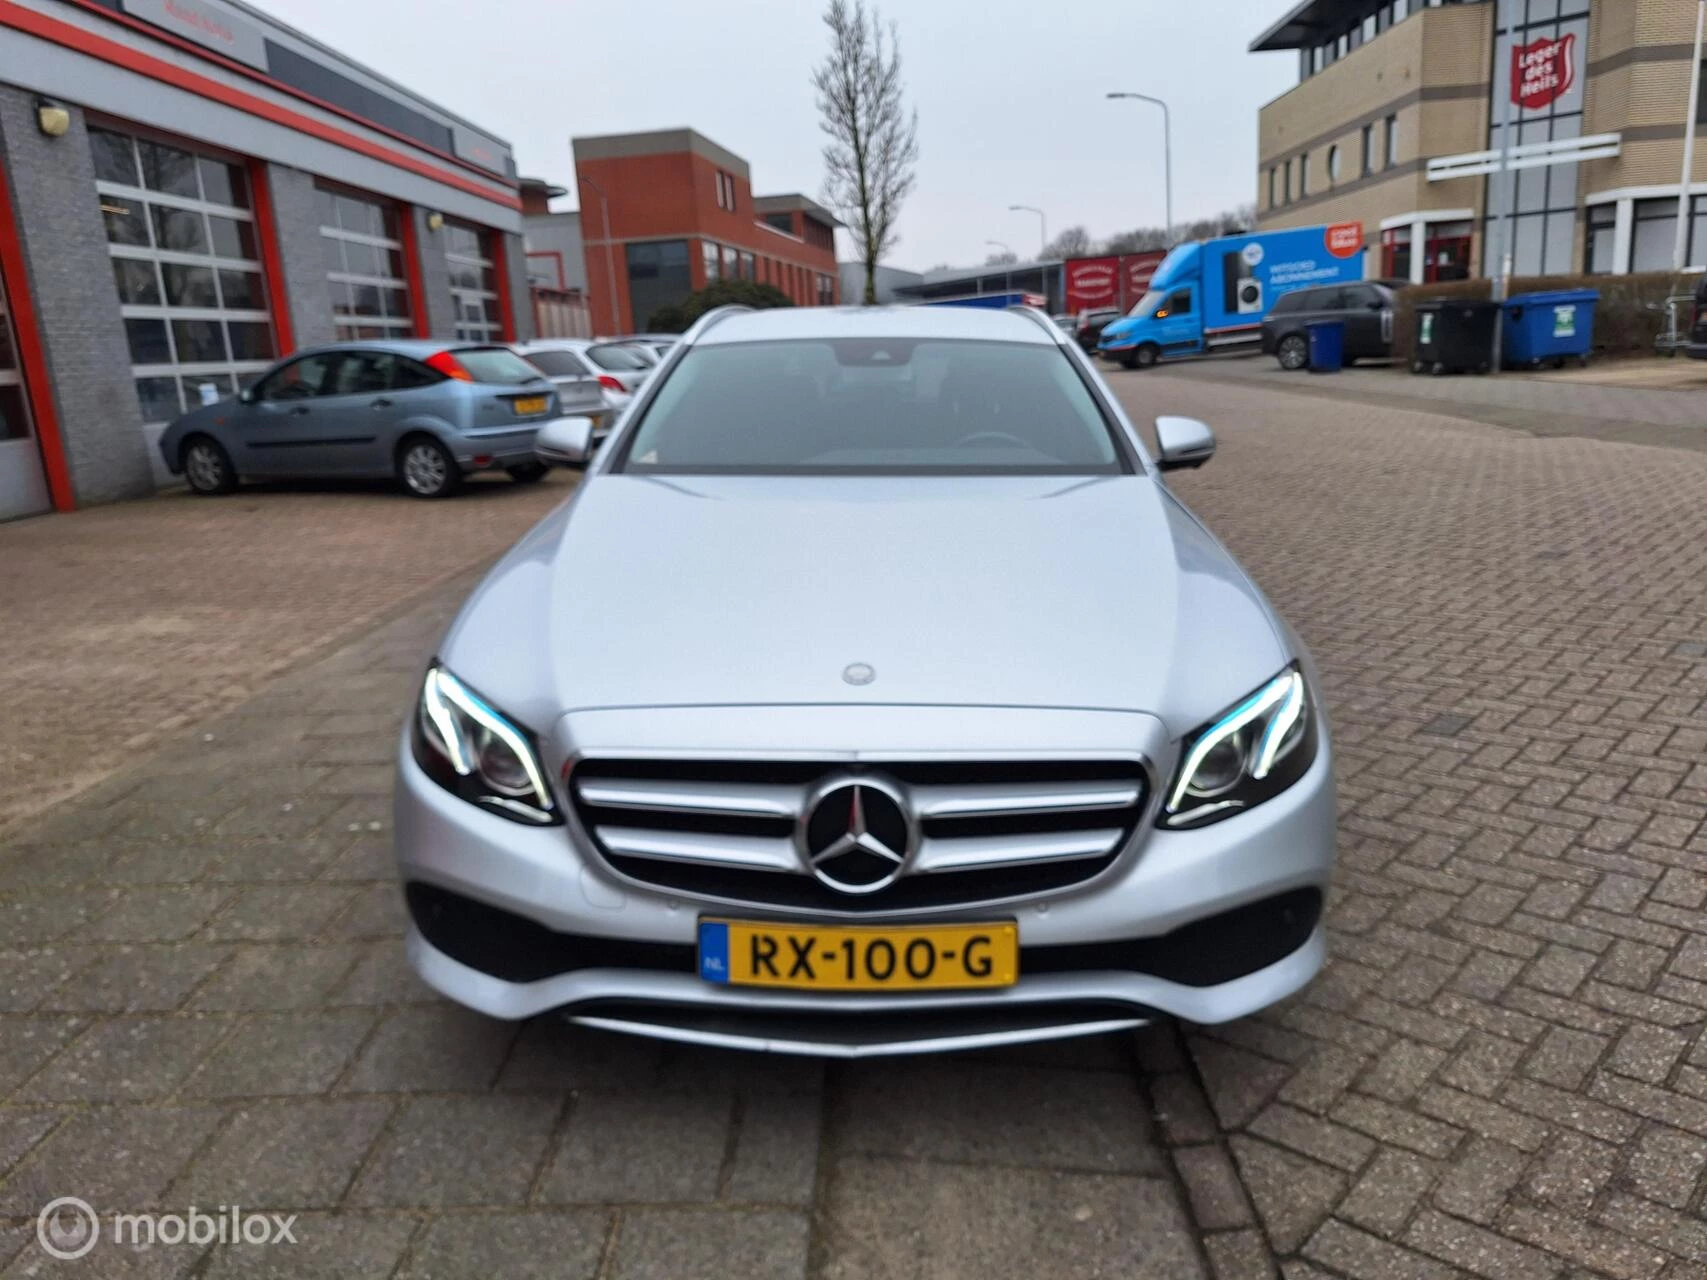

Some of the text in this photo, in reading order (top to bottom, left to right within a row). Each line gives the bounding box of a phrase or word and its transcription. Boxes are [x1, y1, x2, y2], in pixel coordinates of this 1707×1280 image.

[1519, 42, 1562, 69] Leger
[1525, 60, 1553, 81] des
[1520, 74, 1558, 97] Heils
[704, 957, 724, 971] NL
[751, 935, 993, 980] RX-100-G
